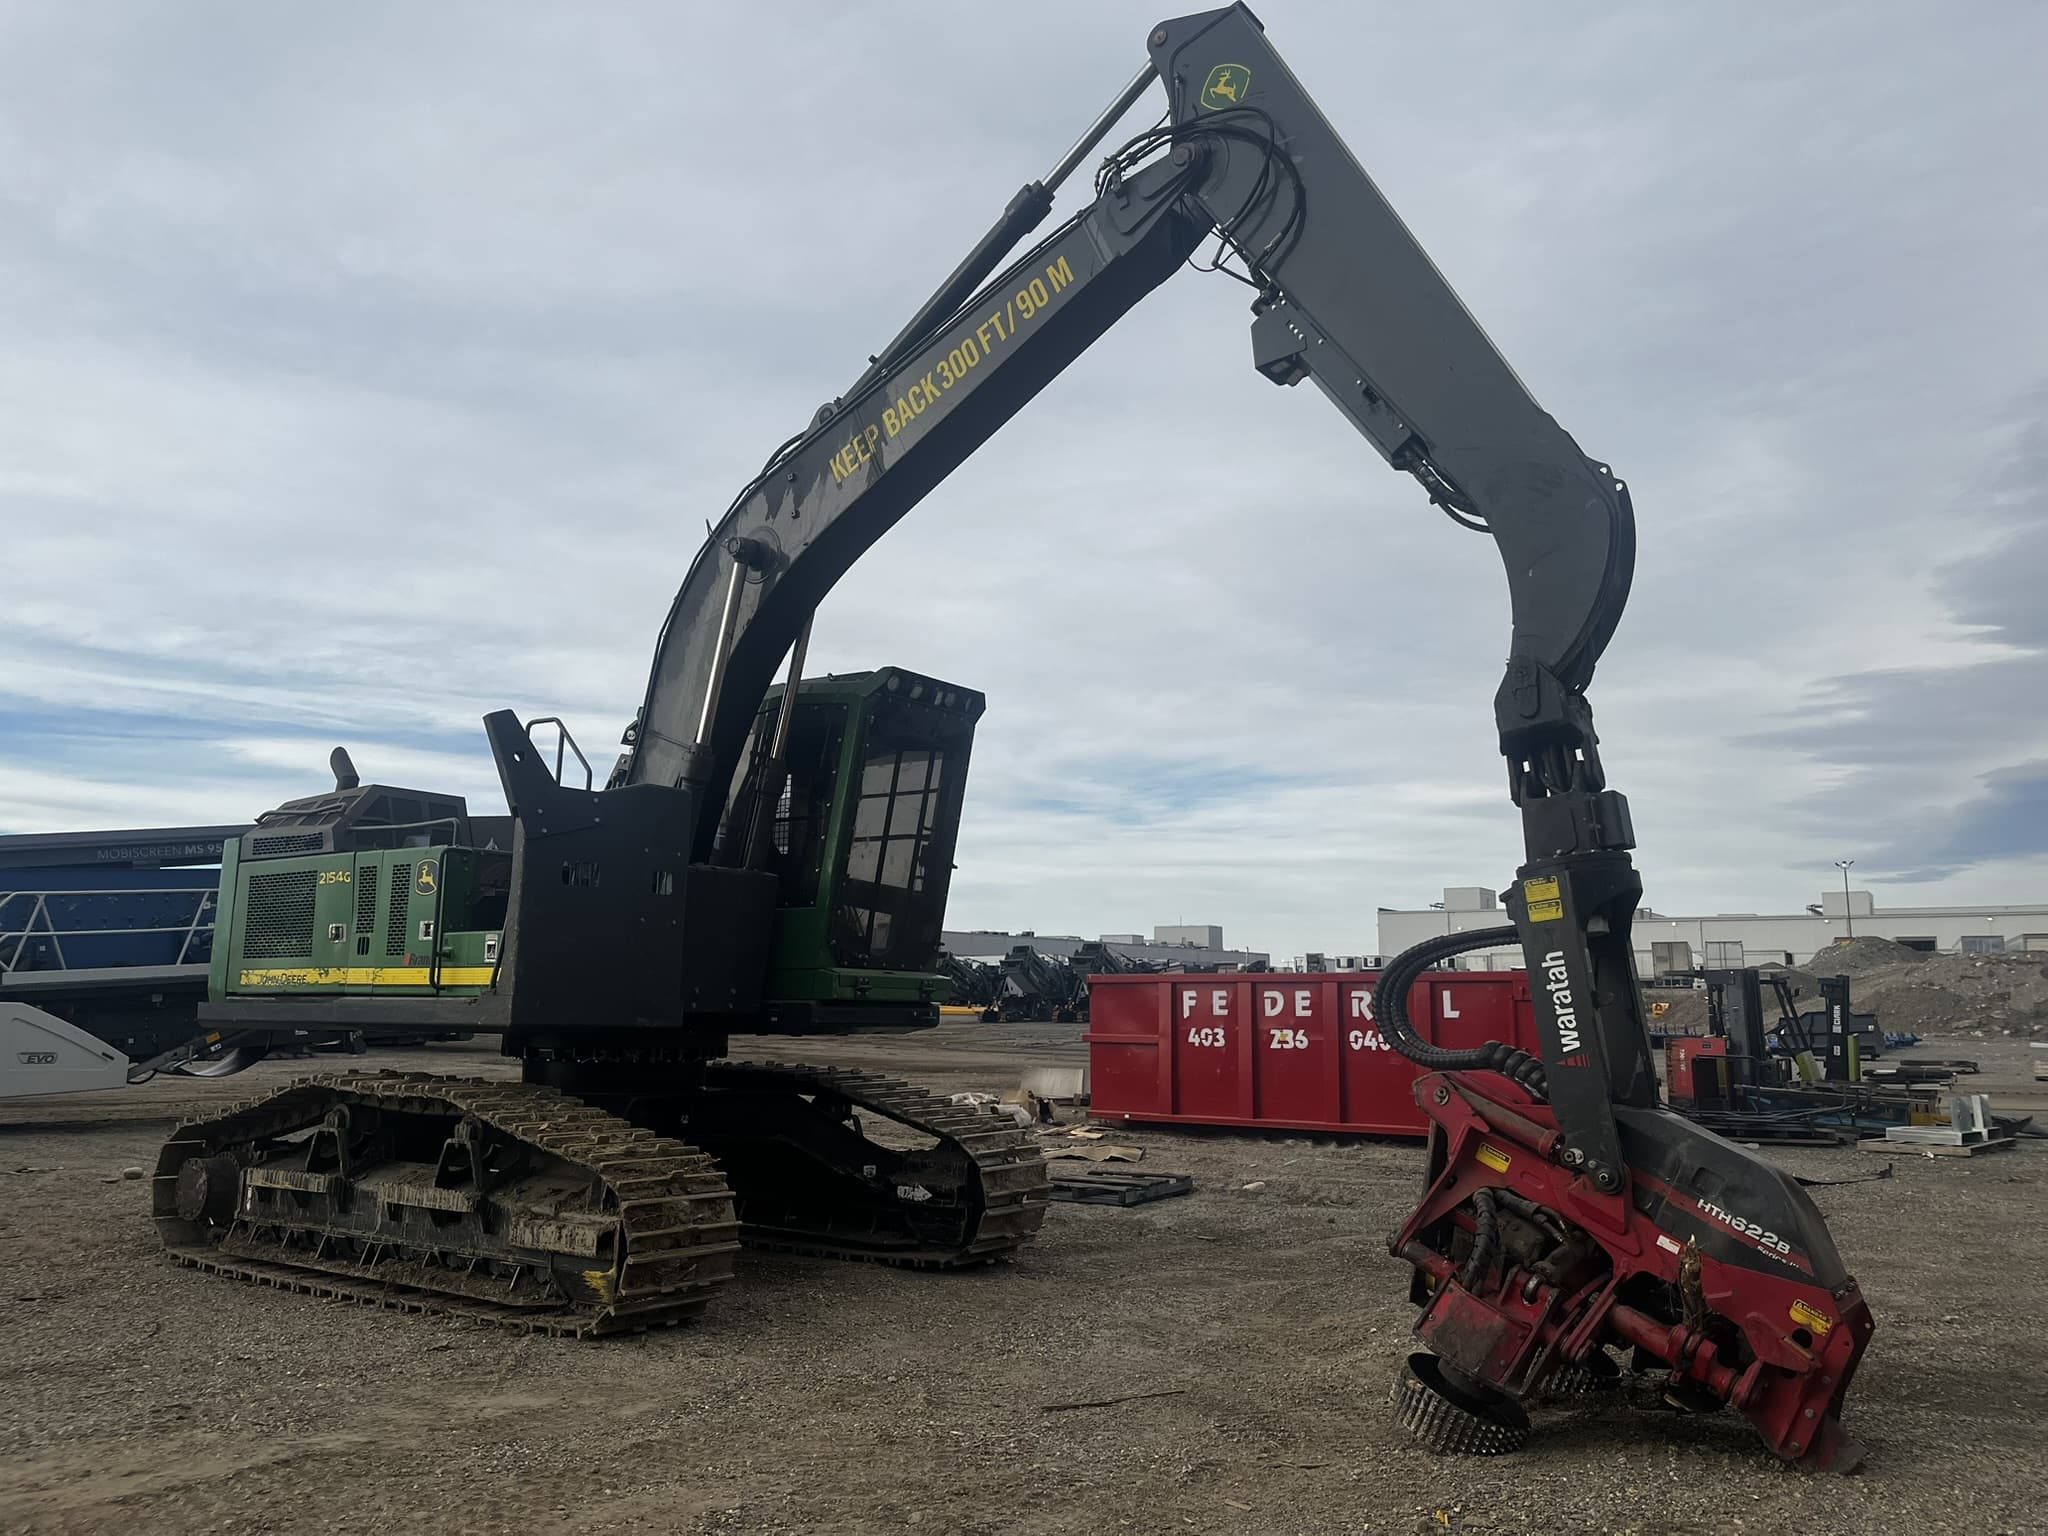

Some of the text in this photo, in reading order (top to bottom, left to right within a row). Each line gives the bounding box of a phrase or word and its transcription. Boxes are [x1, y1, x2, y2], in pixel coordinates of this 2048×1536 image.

[829, 424, 880, 483] KEEP
[882, 372, 942, 438] BACK
[936, 338, 980, 390] 300
[1046, 255, 1075, 294] M
[97, 845, 181, 860] MOBISCREEN
[185, 843, 204, 856] MS
[319, 871, 351, 885] 2154G
[1541, 950, 1581, 1053] waratah
[1187, 1027, 1226, 1048] 403
[1269, 1028, 1309, 1050] 236
[27, 1055, 55, 1064] EVO
[1696, 1198, 1791, 1255] HTH622B
